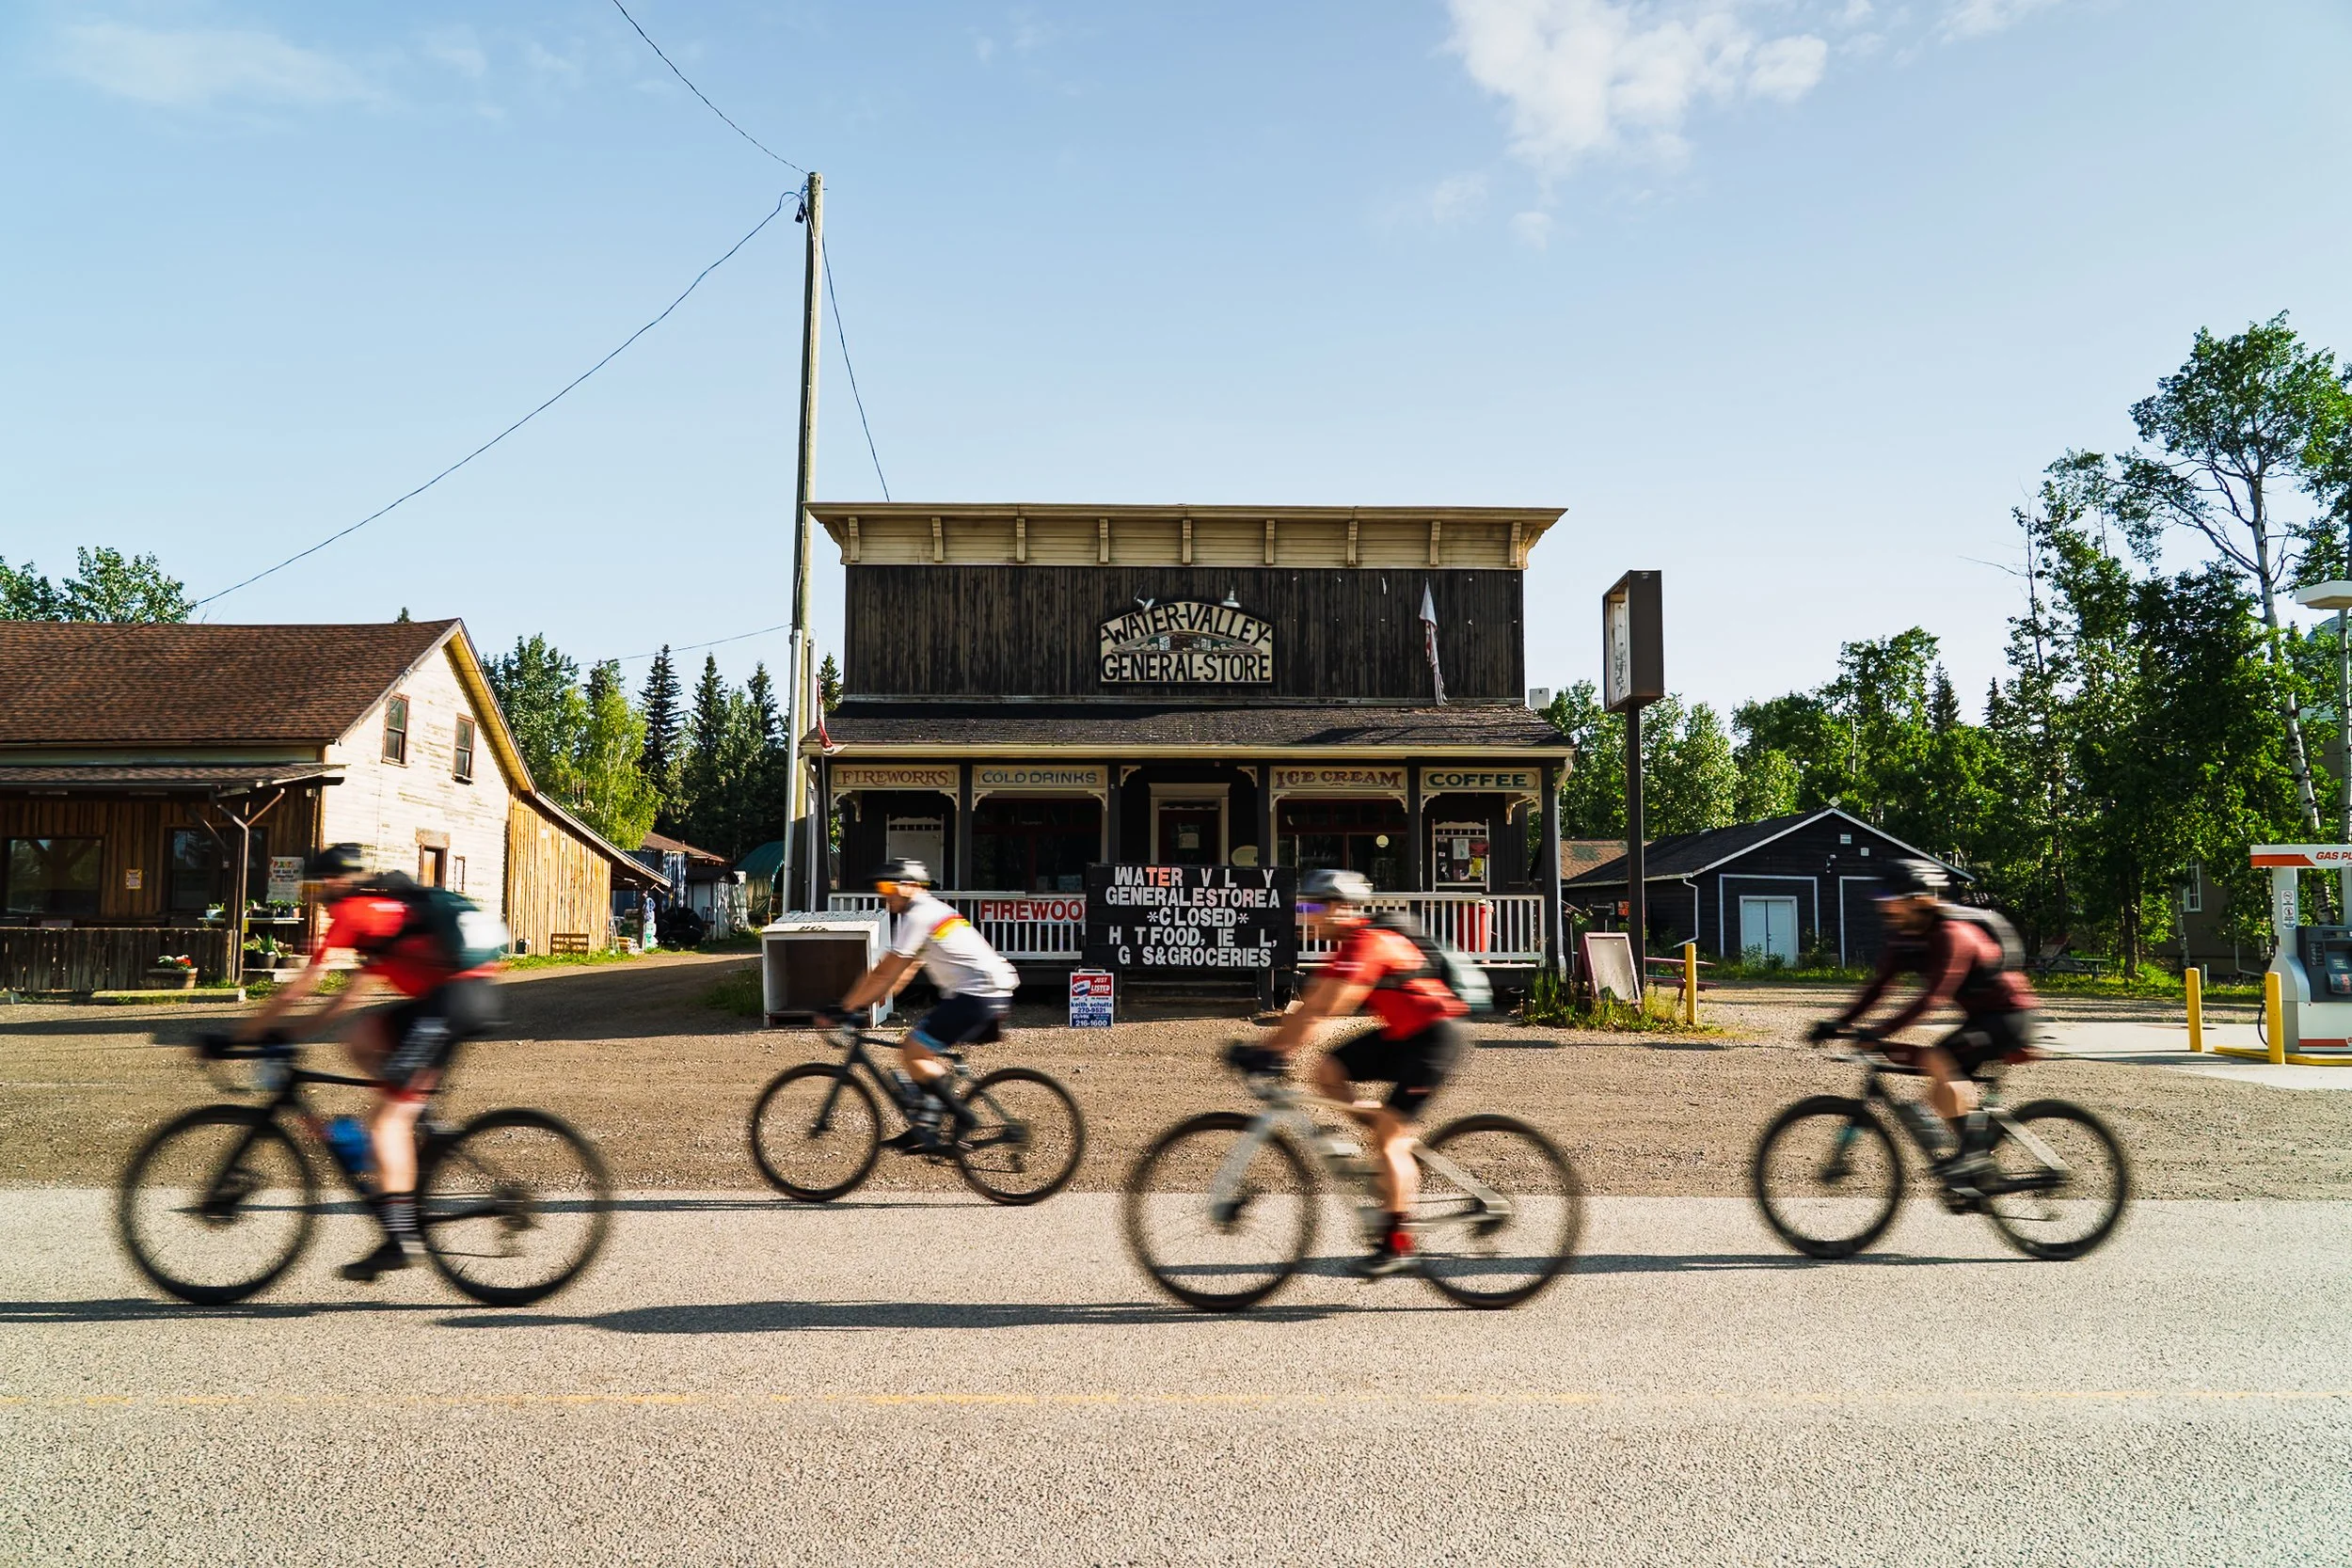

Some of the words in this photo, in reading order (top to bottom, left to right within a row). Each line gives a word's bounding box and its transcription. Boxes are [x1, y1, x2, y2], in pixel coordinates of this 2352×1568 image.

[842, 770, 948, 785] FIREWORKS
[981, 771, 1026, 784] COLD
[1029, 771, 1098, 784] DRINKS
[1276, 770, 1316, 788] ICE
[1320, 770, 1402, 788] CREAM
[1428, 773, 1528, 786] COFFEE
[2316, 851, 2339, 860] GAS
[1115, 866, 1184, 887] WATER
[980, 900, 1085, 920] FIREWOO
